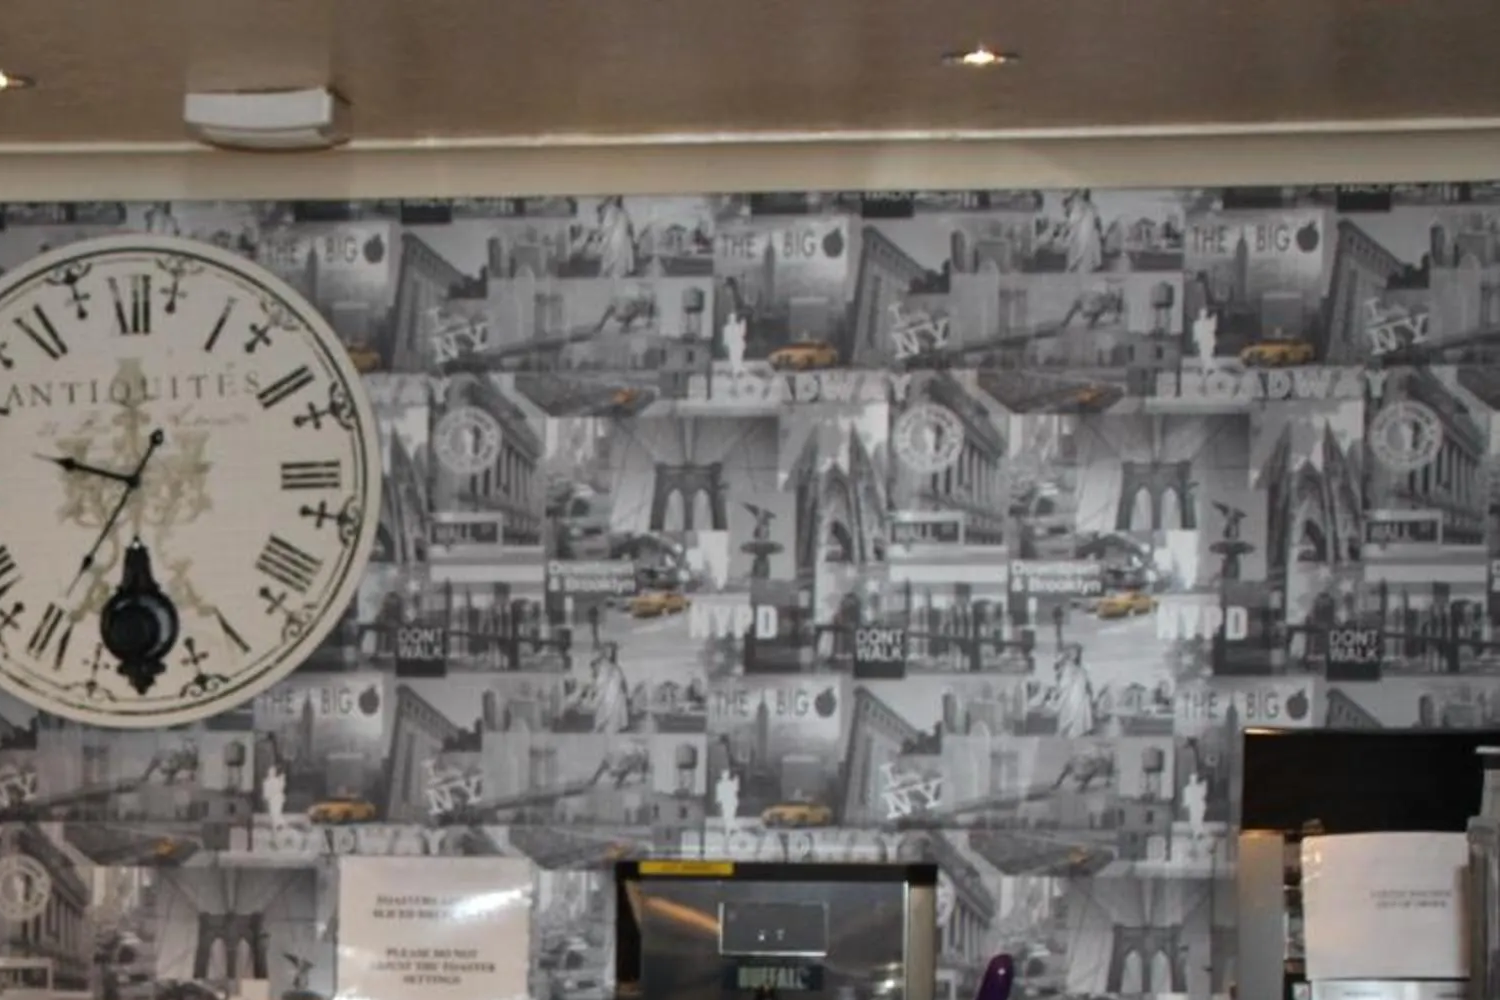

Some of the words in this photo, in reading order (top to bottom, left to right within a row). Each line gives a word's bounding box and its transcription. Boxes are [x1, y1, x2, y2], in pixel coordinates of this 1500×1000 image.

[324, 236, 358, 263] BIG
[720, 231, 758, 260] THE
[781, 229, 816, 258] BIG
[1192, 224, 1226, 254] THE
[1255, 223, 1290, 252] BIG
[891, 318, 950, 360] NY
[1368, 315, 1431, 357] NY
[1029, 578, 1103, 596] Brooklyn
[689, 604, 778, 640] NYPD
[1156, 604, 1248, 641] NYPD
[855, 629, 904, 645] DONT
[1329, 629, 1379, 646] DONT
[857, 646, 905, 662] WALK
[1331, 647, 1381, 663] WALK
[320, 687, 353, 715] BIG
[713, 690, 749, 718] THE
[776, 689, 810, 717] BIG
[1183, 691, 1219, 720] THE
[1244, 690, 1280, 718] BIG
